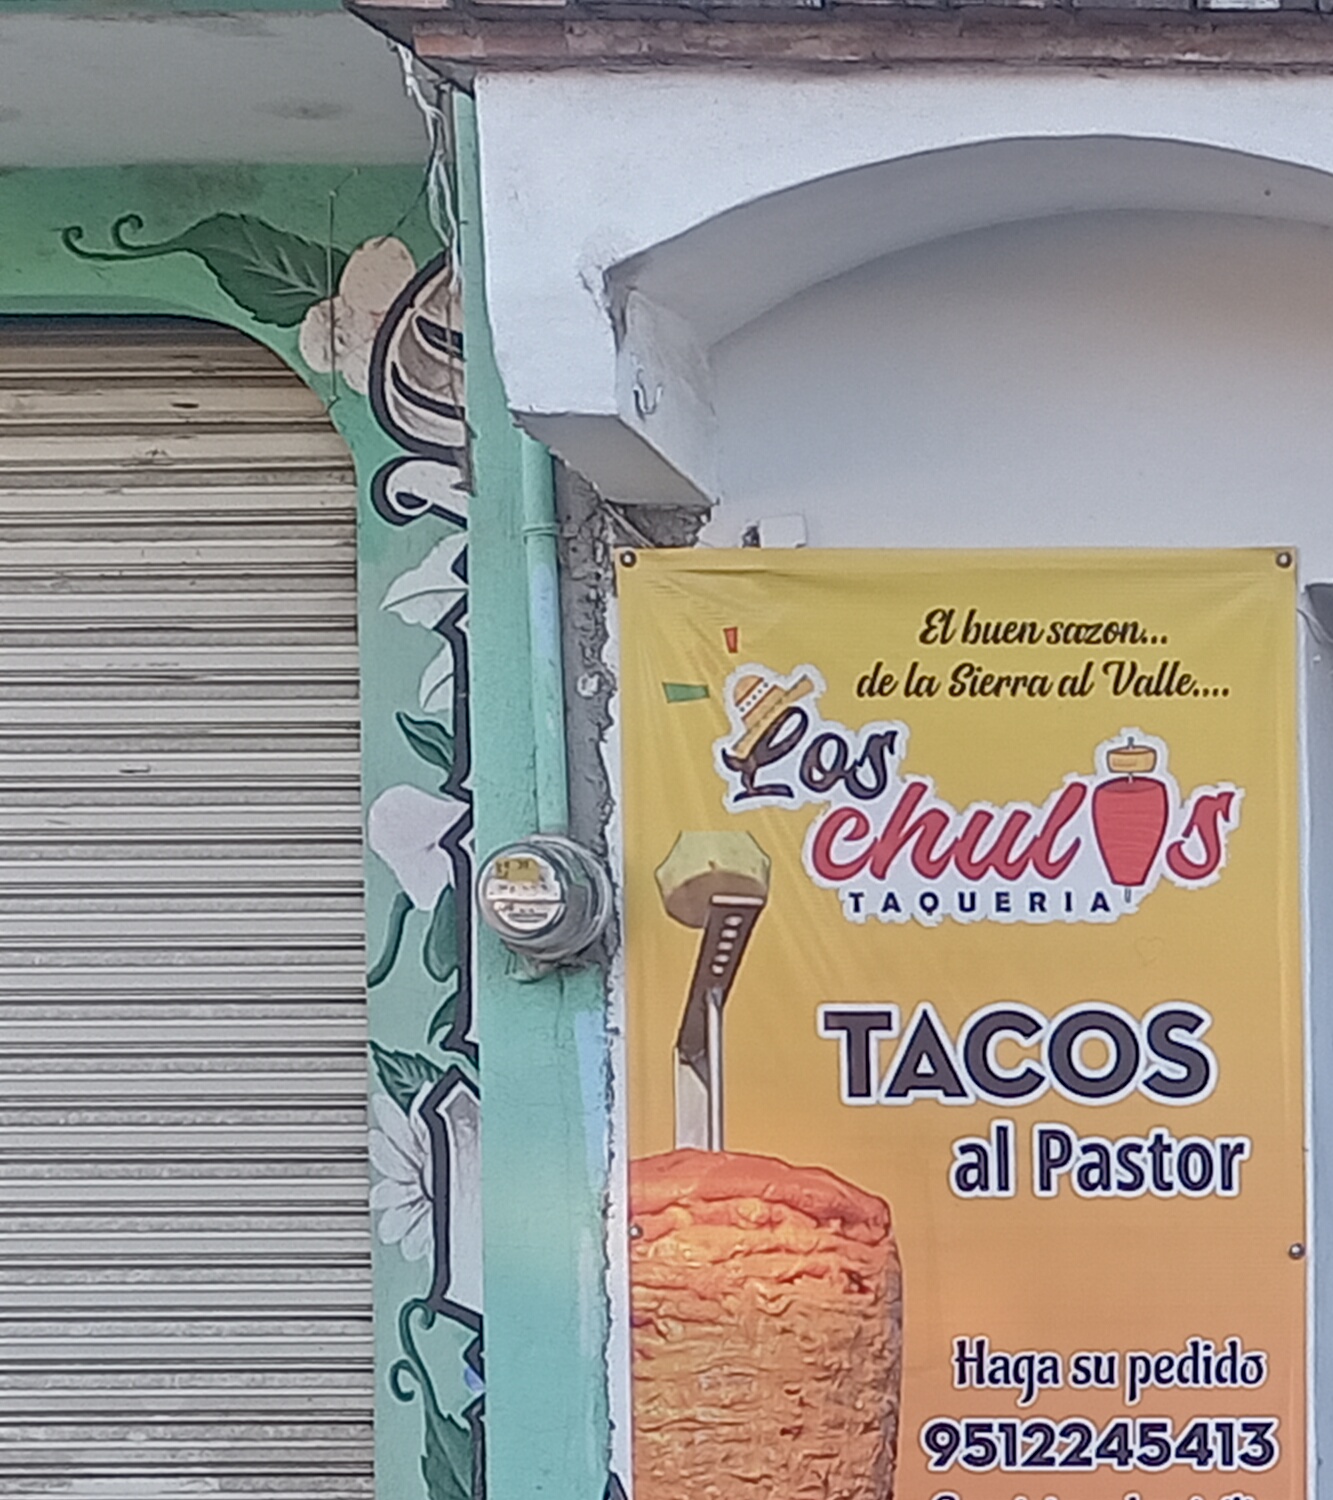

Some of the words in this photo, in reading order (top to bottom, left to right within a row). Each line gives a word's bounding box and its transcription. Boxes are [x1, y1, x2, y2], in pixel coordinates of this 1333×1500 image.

[919, 609, 955, 646] El
[961, 608, 1041, 646] buen
[856, 663, 898, 698] de
[903, 662, 941, 698] la
[948, 662, 1053, 698] Sierra
[1057, 662, 1094, 697] al
[722, 706, 897, 803] Los
[849, 891, 1110, 914] TAQUERIA
[823, 1009, 1211, 1098] TACOS
[954, 1124, 1009, 1192] al
[1037, 1126, 1246, 1193] Pastor
[954, 1338, 1061, 1404] Haga
[1071, 1349, 1116, 1385] su
[1127, 1340, 1266, 1401] pedido
[924, 1422, 1276, 1467] 9512245413
